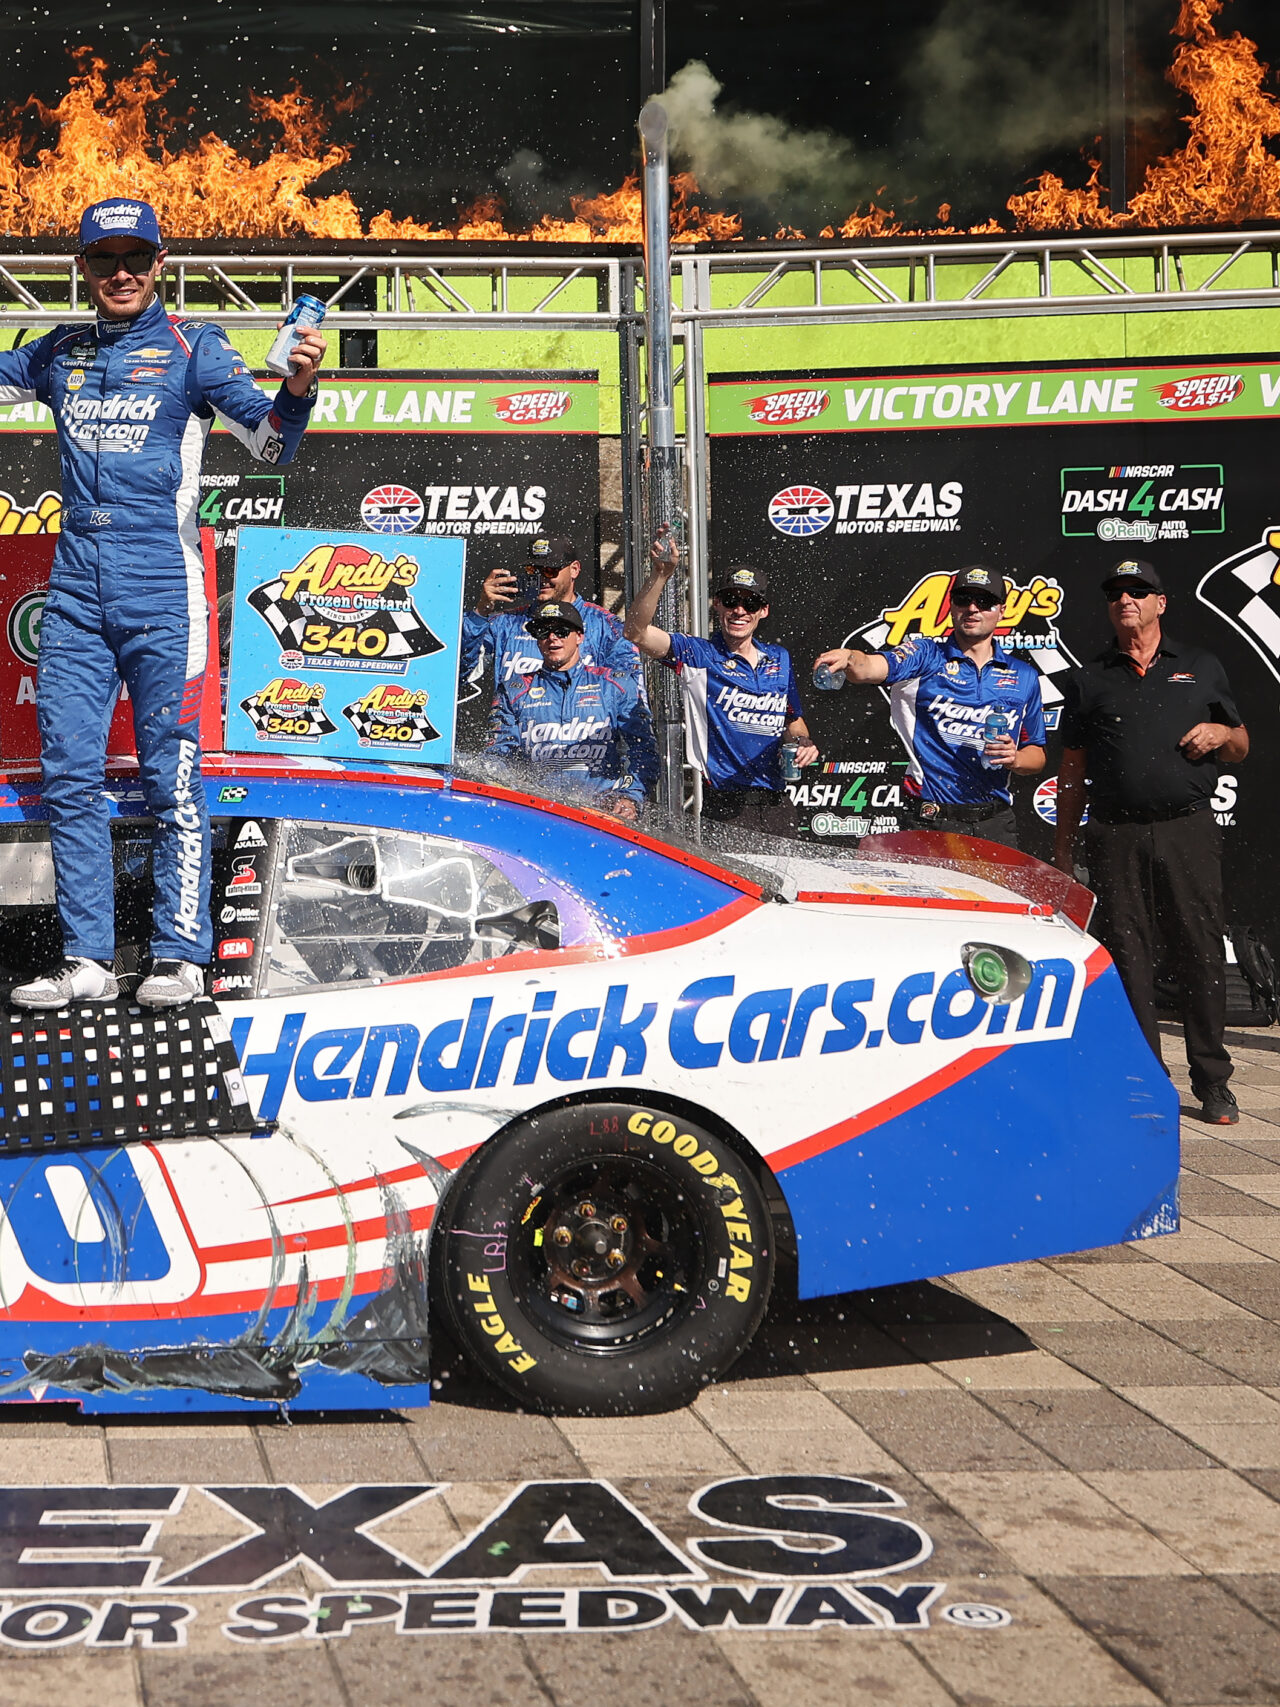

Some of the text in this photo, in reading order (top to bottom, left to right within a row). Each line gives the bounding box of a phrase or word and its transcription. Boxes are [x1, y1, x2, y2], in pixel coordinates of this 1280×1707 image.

[91, 204, 143, 222] Hendrick
[98, 215, 138, 227] Cars.com
[1174, 375, 1242, 397] SPEEDY
[61, 393, 161, 426] Hendrick
[373, 390, 476, 423] LANE
[509, 391, 569, 410] SPEEDY
[764, 390, 828, 411] SPEEDY
[844, 378, 1138, 422] VICTORY LANE
[69, 422, 150, 441] Cars.com
[1125, 465, 1174, 478] NASCAR
[424, 486, 547, 521] TEXAS
[835, 482, 963, 519] TEXAS
[1062, 480, 1223, 517] DASH 4 CASH
[225, 498, 283, 520] CASH
[425, 522, 471, 535] MOTOR
[835, 520, 883, 534] MOTOR
[1101, 520, 1158, 540] O'Reilly
[1158, 529, 1189, 539] PARTS
[1161, 521, 1187, 530] AUTO
[281, 546, 419, 600] Andy's
[298, 591, 412, 612] Frozen Custard
[301, 624, 389, 656] 340
[306, 657, 404, 671] TEXAS MOTOR SPEEDWAY
[257, 679, 325, 706] Andy's
[360, 686, 428, 712] Andy's
[267, 718, 310, 734] 340
[728, 707, 785, 727] Cars.com
[369, 725, 412, 741] 340
[838, 762, 886, 773] NASCAR
[840, 776, 868, 812] 4
[816, 815, 868, 835] O'Reilly
[873, 816, 897, 825] AUTO
[233, 839, 268, 850] AXALTA
[222, 942, 248, 956] SEM
[628, 1112, 754, 1303] GOODYEAR
[467, 1272, 538, 1374] EAGLE
